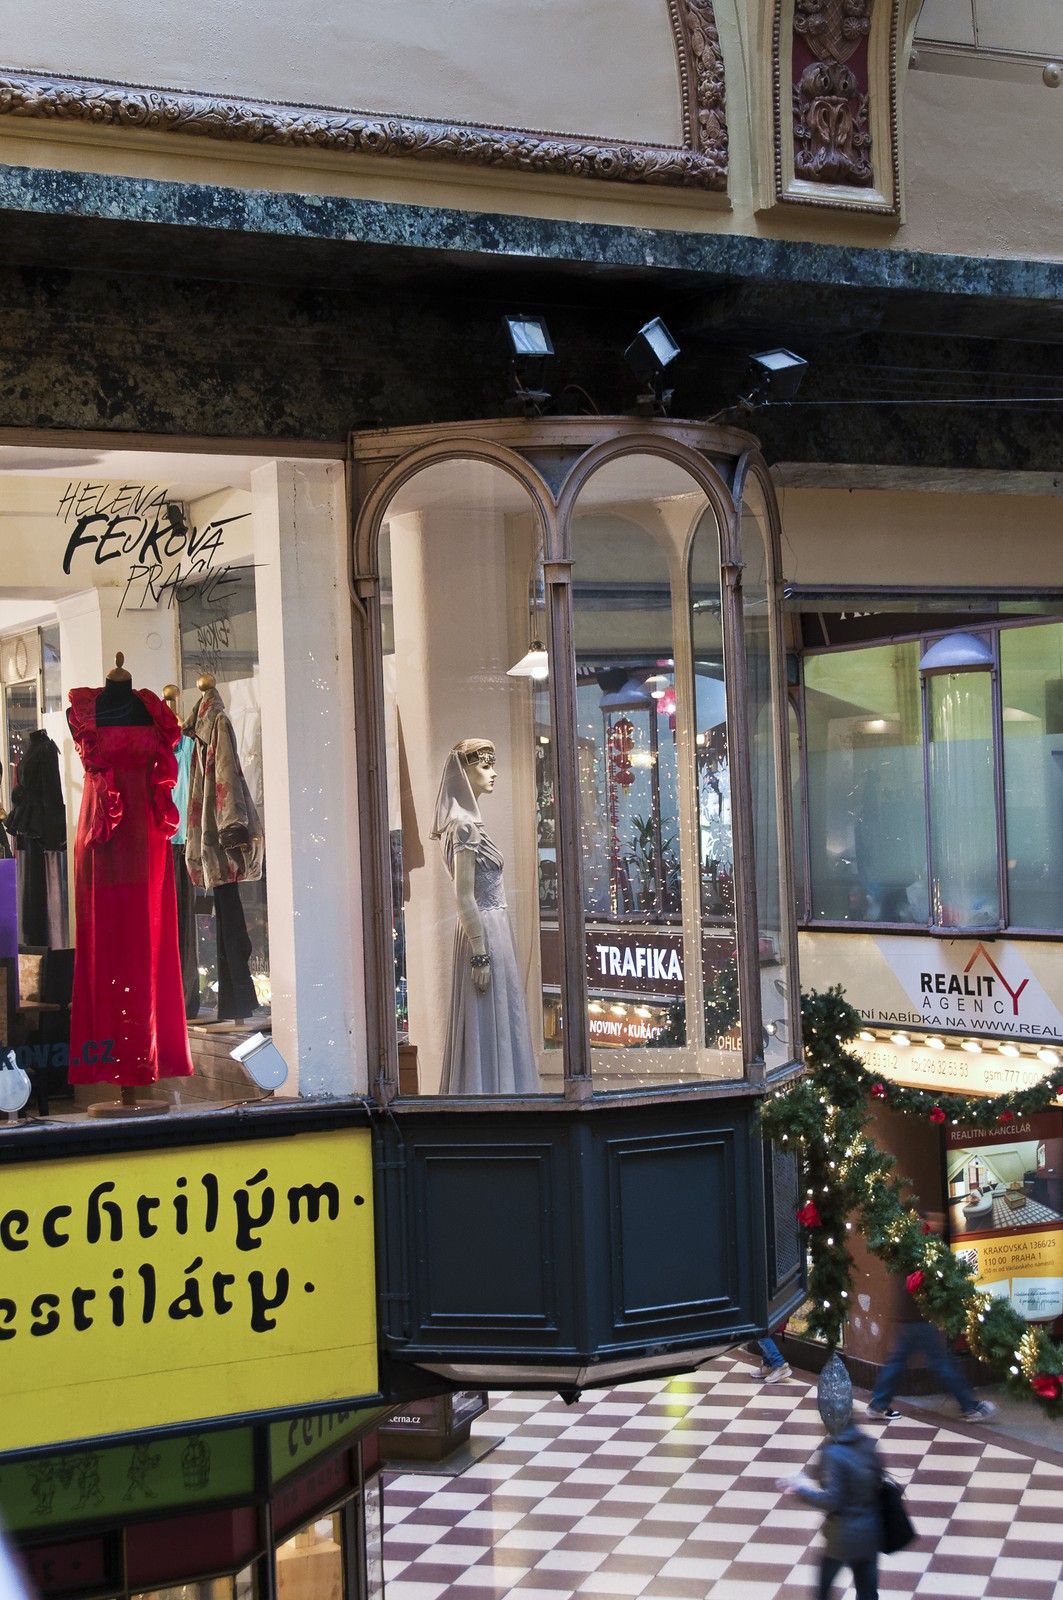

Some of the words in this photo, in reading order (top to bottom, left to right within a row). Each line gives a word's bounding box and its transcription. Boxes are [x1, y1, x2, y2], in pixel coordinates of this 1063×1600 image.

[57, 481, 169, 526] HELENA
[117, 556, 271, 619] PRAGUE
[596, 945, 684, 981] TRAFIKA
[589, 1020, 623, 1037] NOVINY
[878, 1010, 942, 1026] NABÍDKA
[945, 1017, 966, 1029] NA
[959, 1062, 969, 1077] 53
[984, 1258, 996, 1266] 110
[997, 1256, 1007, 1265] 00
[1011, 1253, 1036, 1262] PRAHA
[1038, 1252, 1042, 1260] 1
